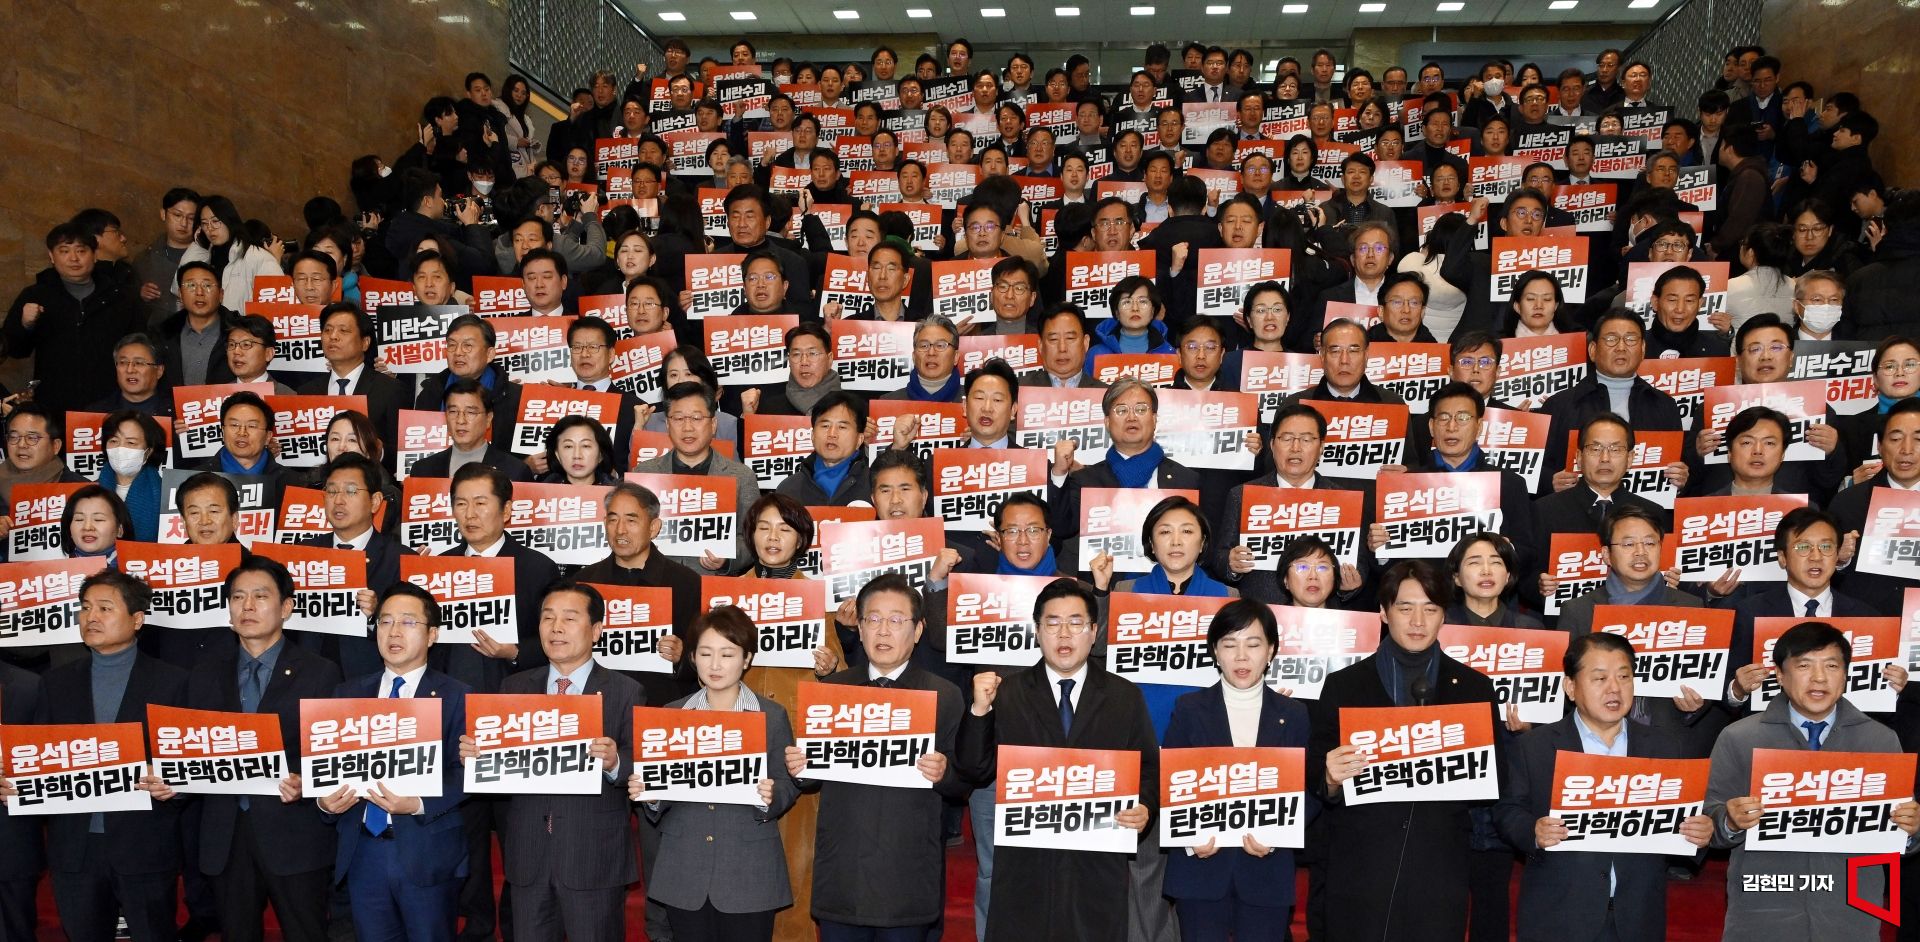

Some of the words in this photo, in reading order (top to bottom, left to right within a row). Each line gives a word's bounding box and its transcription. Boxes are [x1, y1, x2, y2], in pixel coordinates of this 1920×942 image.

[720, 83, 765, 102] 내란수괴
[852, 84, 895, 102] 내란수괴
[925, 80, 968, 101] 내란수괴
[652, 114, 697, 134] 내란수괴
[1029, 108, 1072, 126] 윤석열을
[839, 143, 873, 159] 윤석열
[1518, 130, 1570, 148] 내란수괴
[1472, 163, 1521, 182] 윤석열을
[1021, 184, 1056, 200] 석열을
[1555, 191, 1606, 211] 윤석열을
[1203, 258, 1274, 285] 윤석열을
[1498, 246, 1571, 272] 윤석열을
[691, 265, 743, 289] 윤석열
[939, 267, 994, 296] 윤석열
[940, 291, 994, 316] 탄핵하
[273, 315, 321, 337] 석열을
[711, 325, 783, 352] 윤석열을
[612, 345, 662, 374] 석열을
[712, 346, 789, 378] 탄핵하라
[1366, 353, 1441, 378] 윤석열을
[1826, 377, 1877, 402] 하라!
[876, 413, 956, 440] 윤열을
[1326, 415, 1388, 440] 석열을
[751, 427, 812, 456] 윤석열
[1323, 442, 1399, 467] 핵하라!
[941, 461, 1027, 492] 윤석열을
[15, 494, 66, 523] 윤석열
[511, 496, 597, 524] 윤석열을
[659, 487, 717, 514] 석열을
[660, 516, 732, 543] 핵하라!
[1247, 501, 1341, 531] 윤석열을
[287, 560, 345, 586] 석열을
[292, 591, 361, 618] 핵하라!
[956, 624, 1036, 655] 탄핵하
[1634, 653, 1722, 682] 핵하라!
[310, 712, 417, 753] 윤석열을
[474, 708, 579, 748] 윤석열을
[805, 703, 911, 734] 윤석열을
[157, 725, 258, 755] 윤석열을
[642, 724, 742, 759] 윤석열을
[805, 737, 929, 770] 탄핵하라!
[1349, 720, 1464, 761] 윤석열을
[10, 737, 120, 774] 윤석열을
[312, 744, 436, 788] 탄핵하라!
[160, 755, 280, 787] 탄핵하라!
[642, 758, 761, 791] 탄핵하라!
[1005, 765, 1115, 800] 윤석열을
[1169, 761, 1279, 803] 윤석열을
[1353, 749, 1488, 795] 탄핵하라!
[15, 765, 141, 807] 탄핵하라!
[1562, 773, 1682, 807] 윤석열을
[1761, 768, 1887, 804] 윤석열을
[1170, 796, 1298, 838] 탄핵하라!
[1758, 800, 1900, 841] 탄핵하라!
